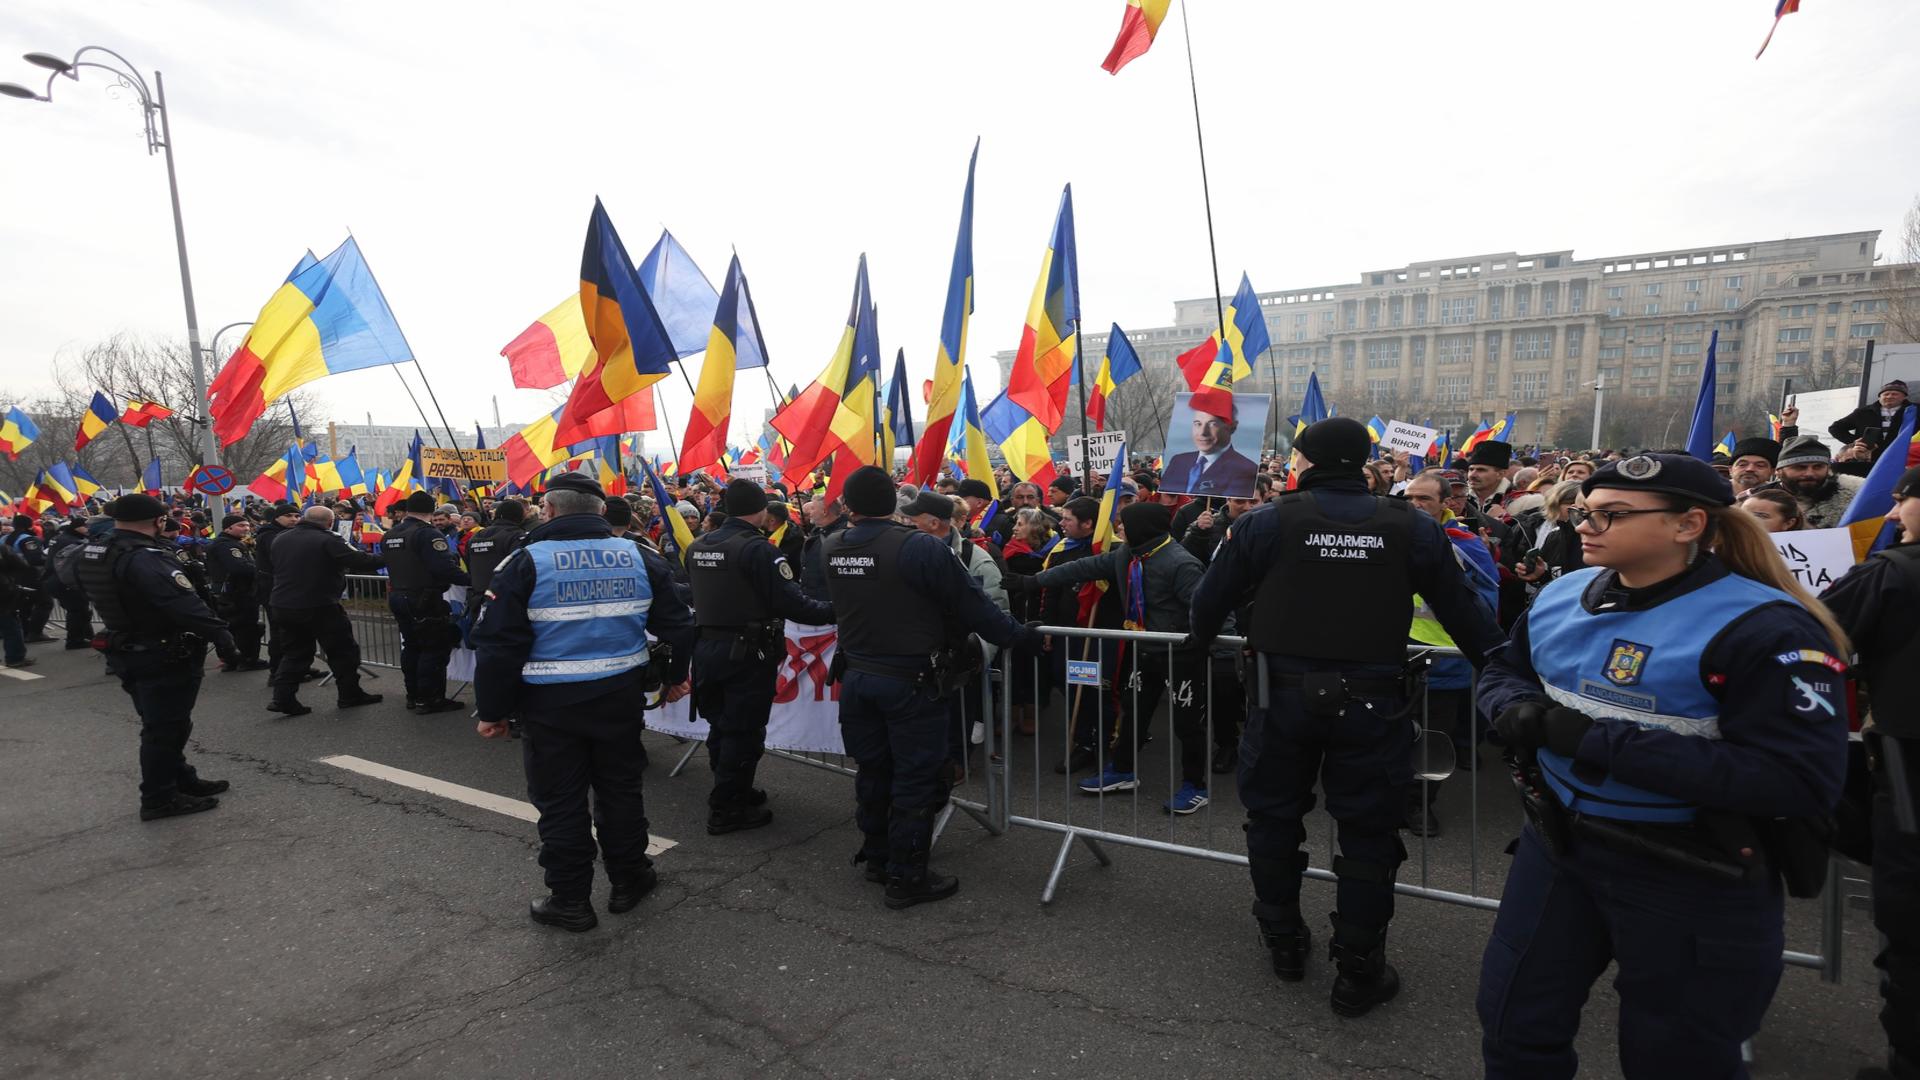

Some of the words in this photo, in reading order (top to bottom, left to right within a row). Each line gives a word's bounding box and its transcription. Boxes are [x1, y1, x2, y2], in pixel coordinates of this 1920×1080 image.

[1394, 427, 1427, 439] ORADEA
[1073, 433, 1124, 447] JSTITIE
[1391, 437, 1420, 450] BIHOR
[1090, 446, 1105, 458] NU
[1305, 533, 1384, 549] JANDARMERIA
[556, 550, 632, 570] DIALOG
[1320, 548, 1368, 559] D.G.J.M.B.
[829, 556, 875, 567] JANDARMERIA
[559, 578, 635, 603] JANDARMERIA
